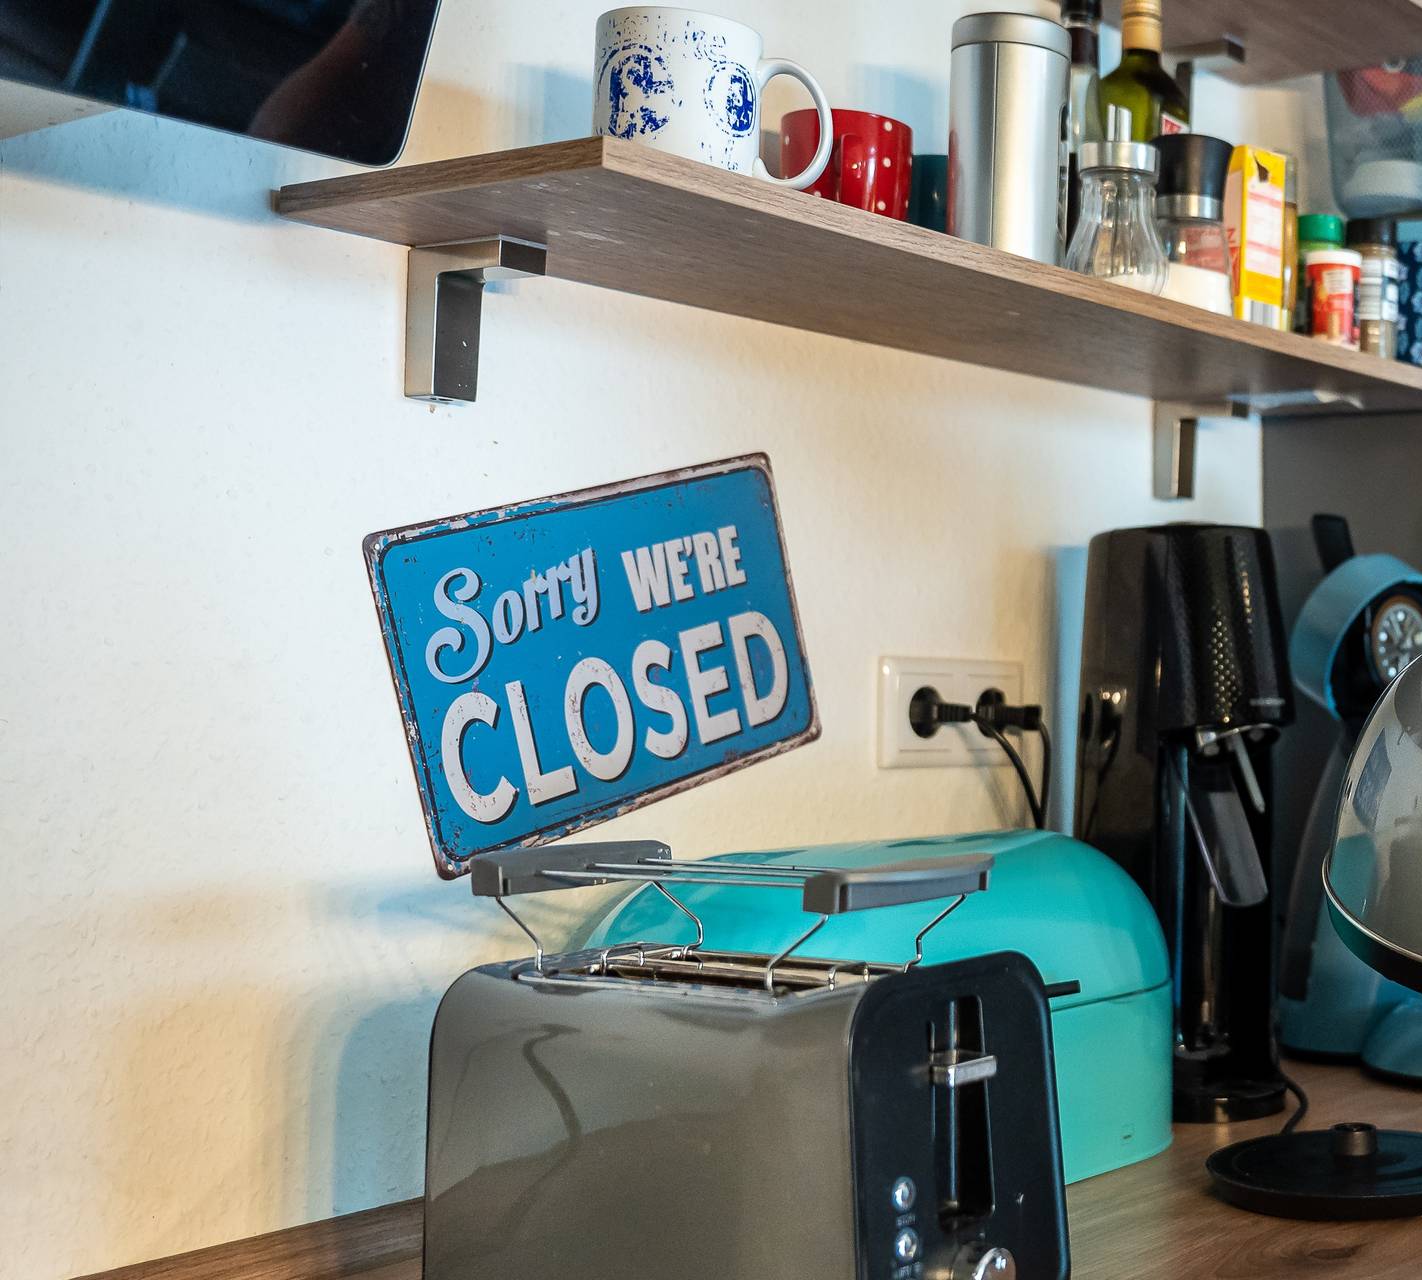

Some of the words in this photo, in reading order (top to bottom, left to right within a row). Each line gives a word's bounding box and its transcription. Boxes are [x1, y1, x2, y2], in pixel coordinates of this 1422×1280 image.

[425, 548, 598, 683] Sorry
[621, 525, 746, 613] WE'RE
[441, 611, 789, 823] CLOSED
